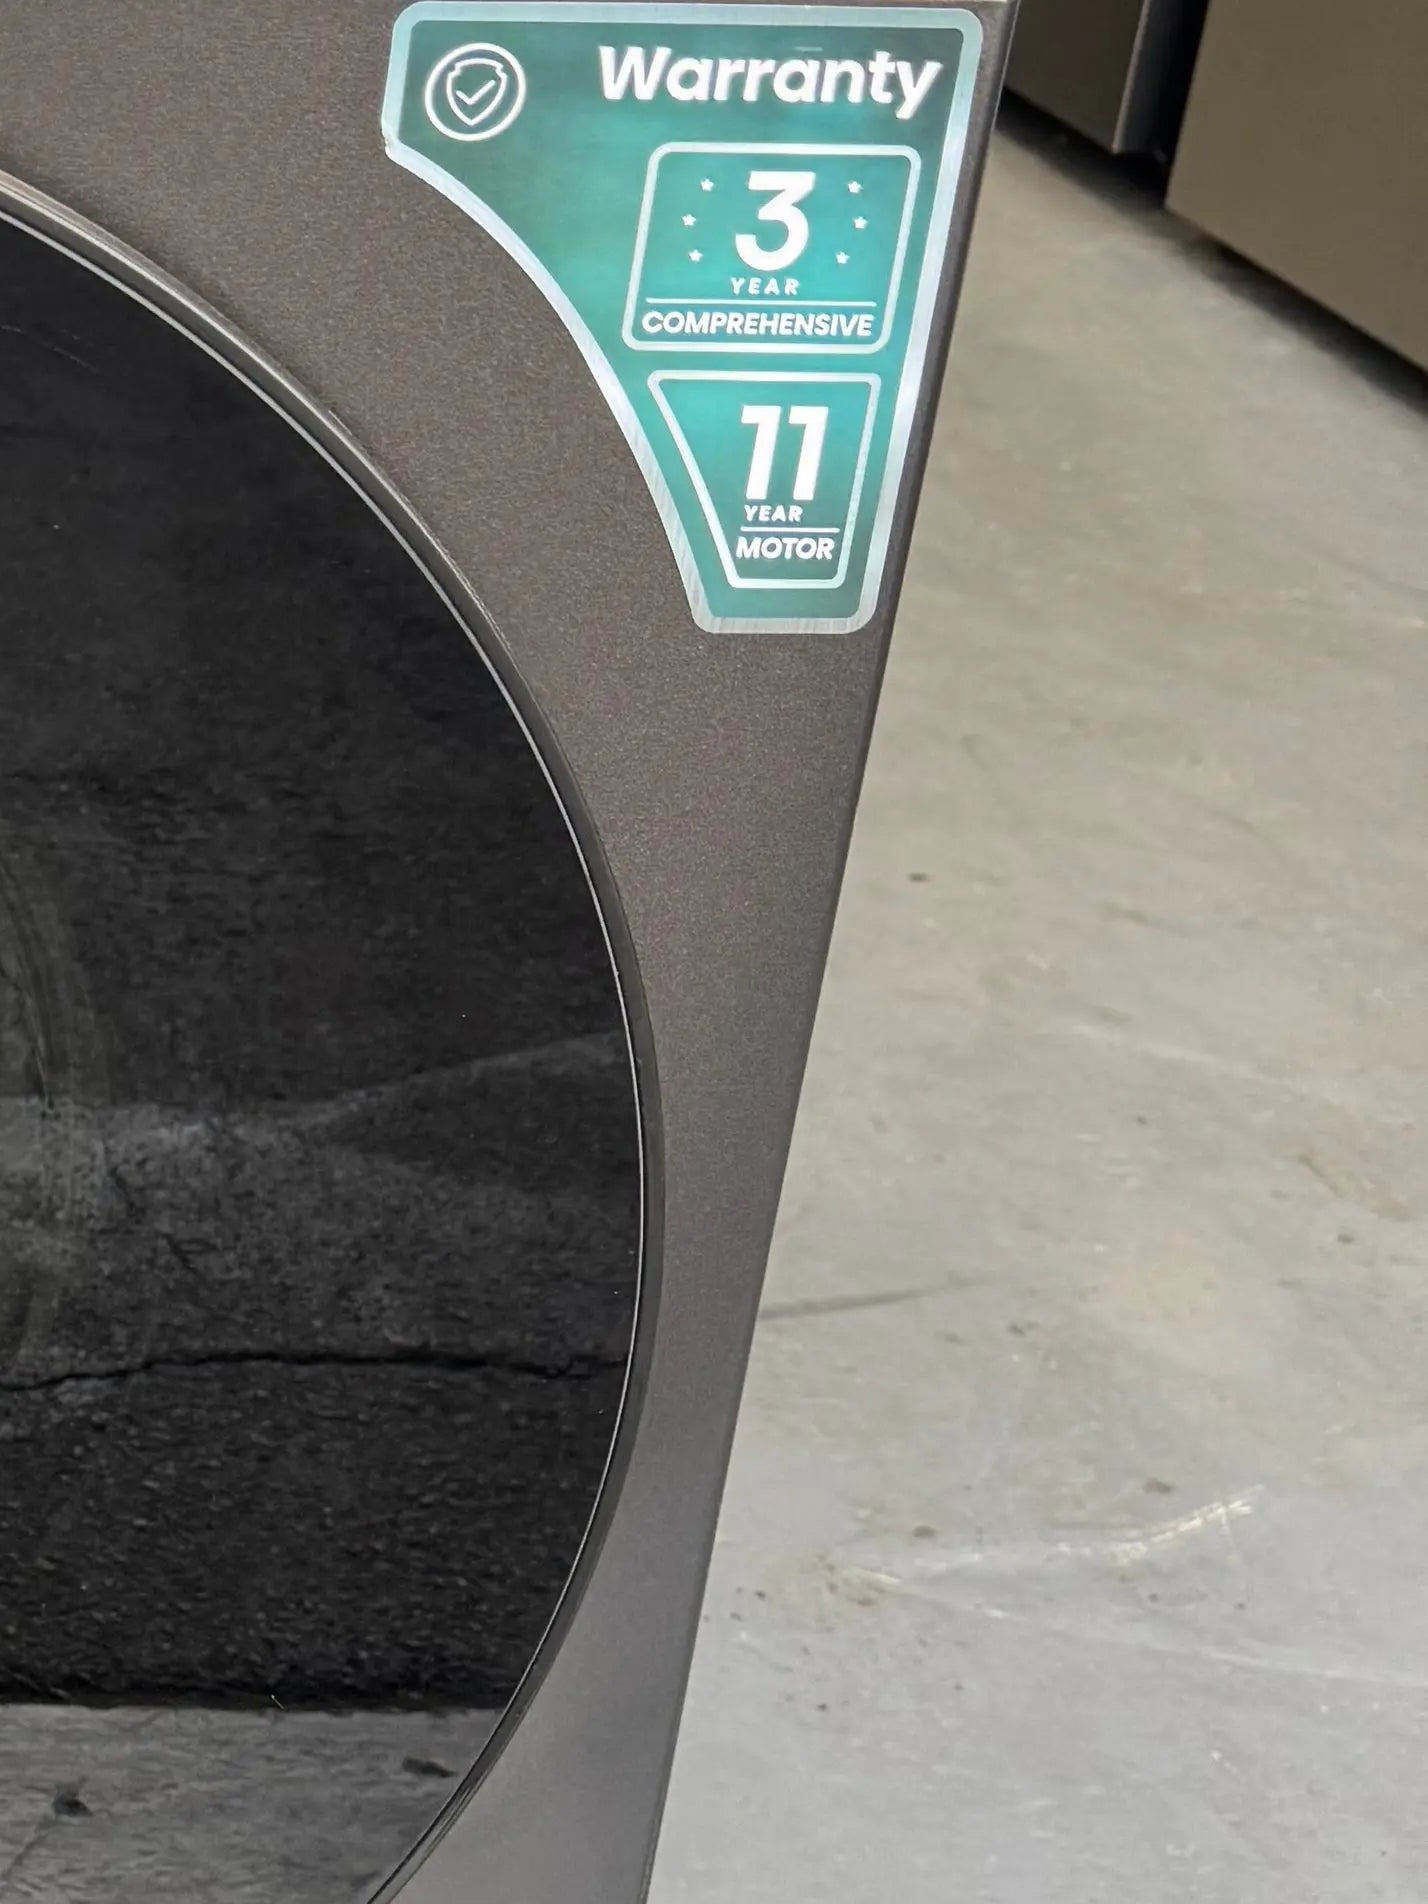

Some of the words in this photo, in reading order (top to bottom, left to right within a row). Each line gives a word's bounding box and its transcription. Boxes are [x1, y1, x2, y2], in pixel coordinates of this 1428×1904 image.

[598, 44, 943, 120] Warranty
[734, 170, 817, 272] 3
[730, 277, 801, 297] YEAR
[640, 309, 875, 339] COMPREHENSIVE
[739, 403, 830, 502] 11
[744, 504, 804, 524] YEAR
[735, 537, 837, 562] MOTOR
